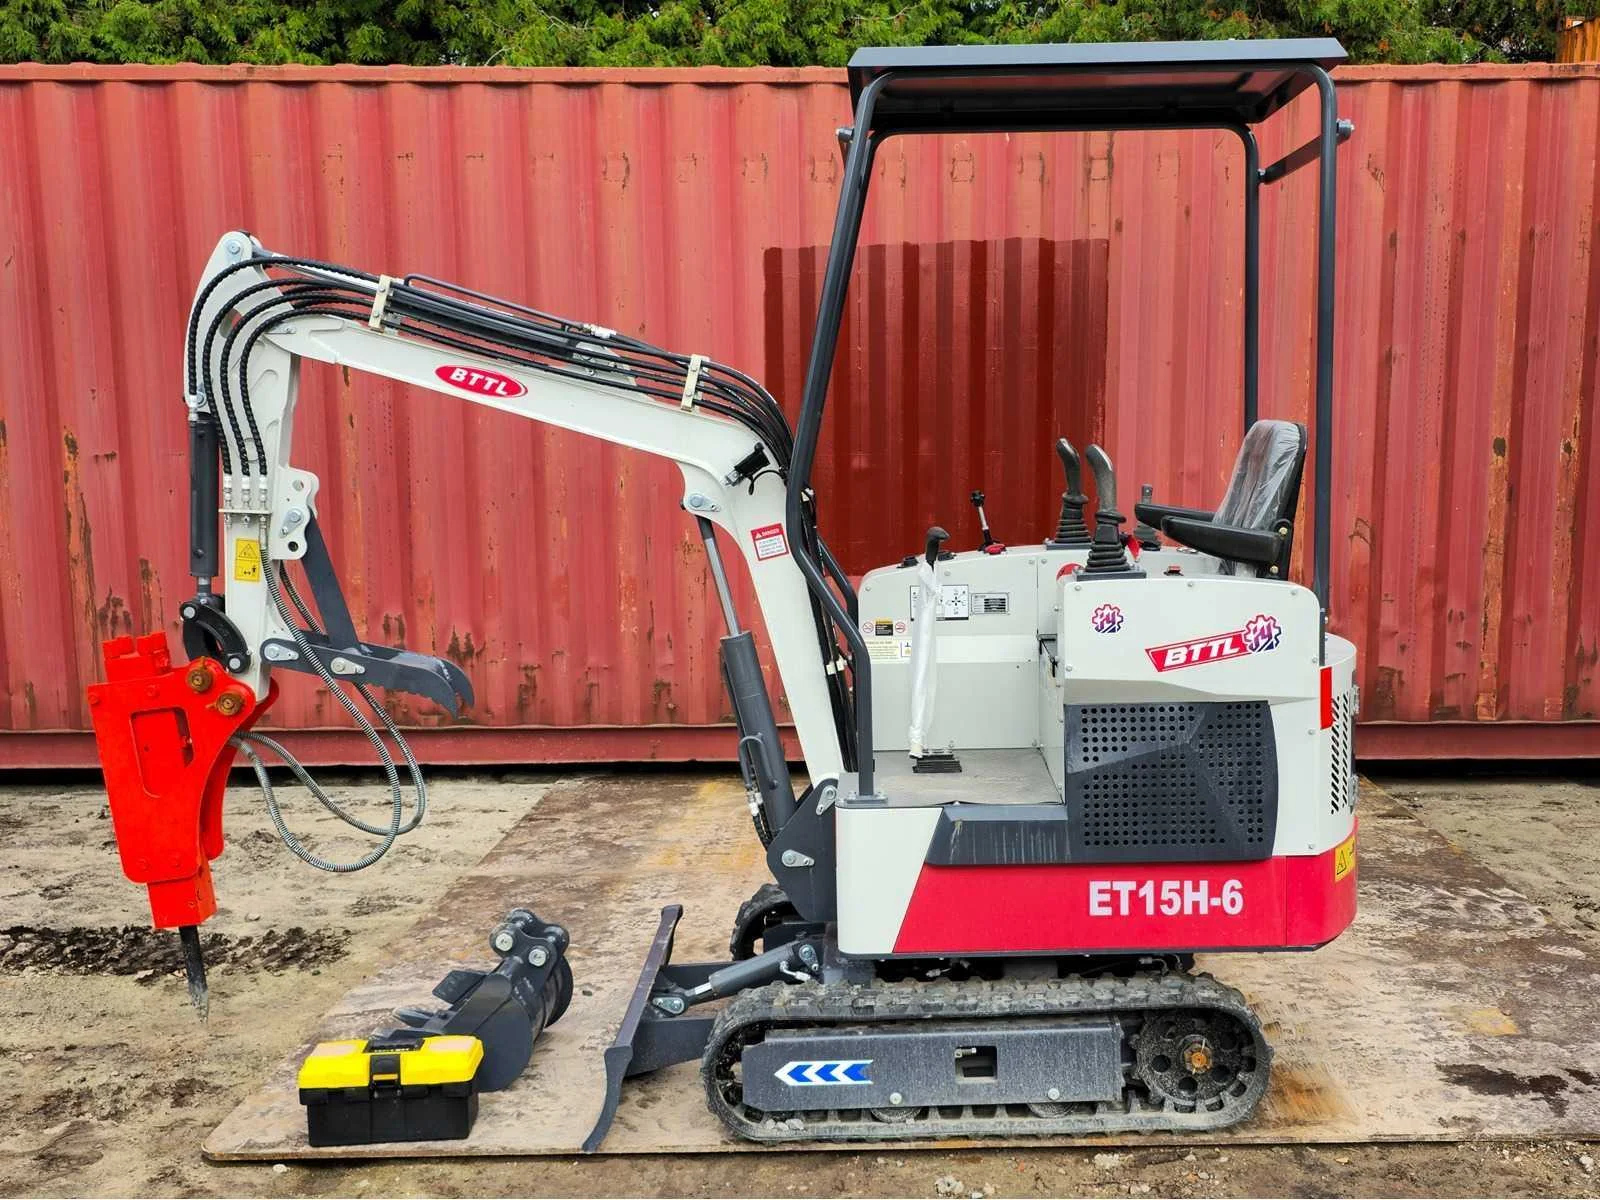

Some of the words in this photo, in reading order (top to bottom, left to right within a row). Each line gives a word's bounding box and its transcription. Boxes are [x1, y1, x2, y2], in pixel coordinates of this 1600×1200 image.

[449, 367, 508, 396] BTTL
[1164, 636, 1241, 667] BTTL
[1089, 879, 1244, 916] ET15H-6
